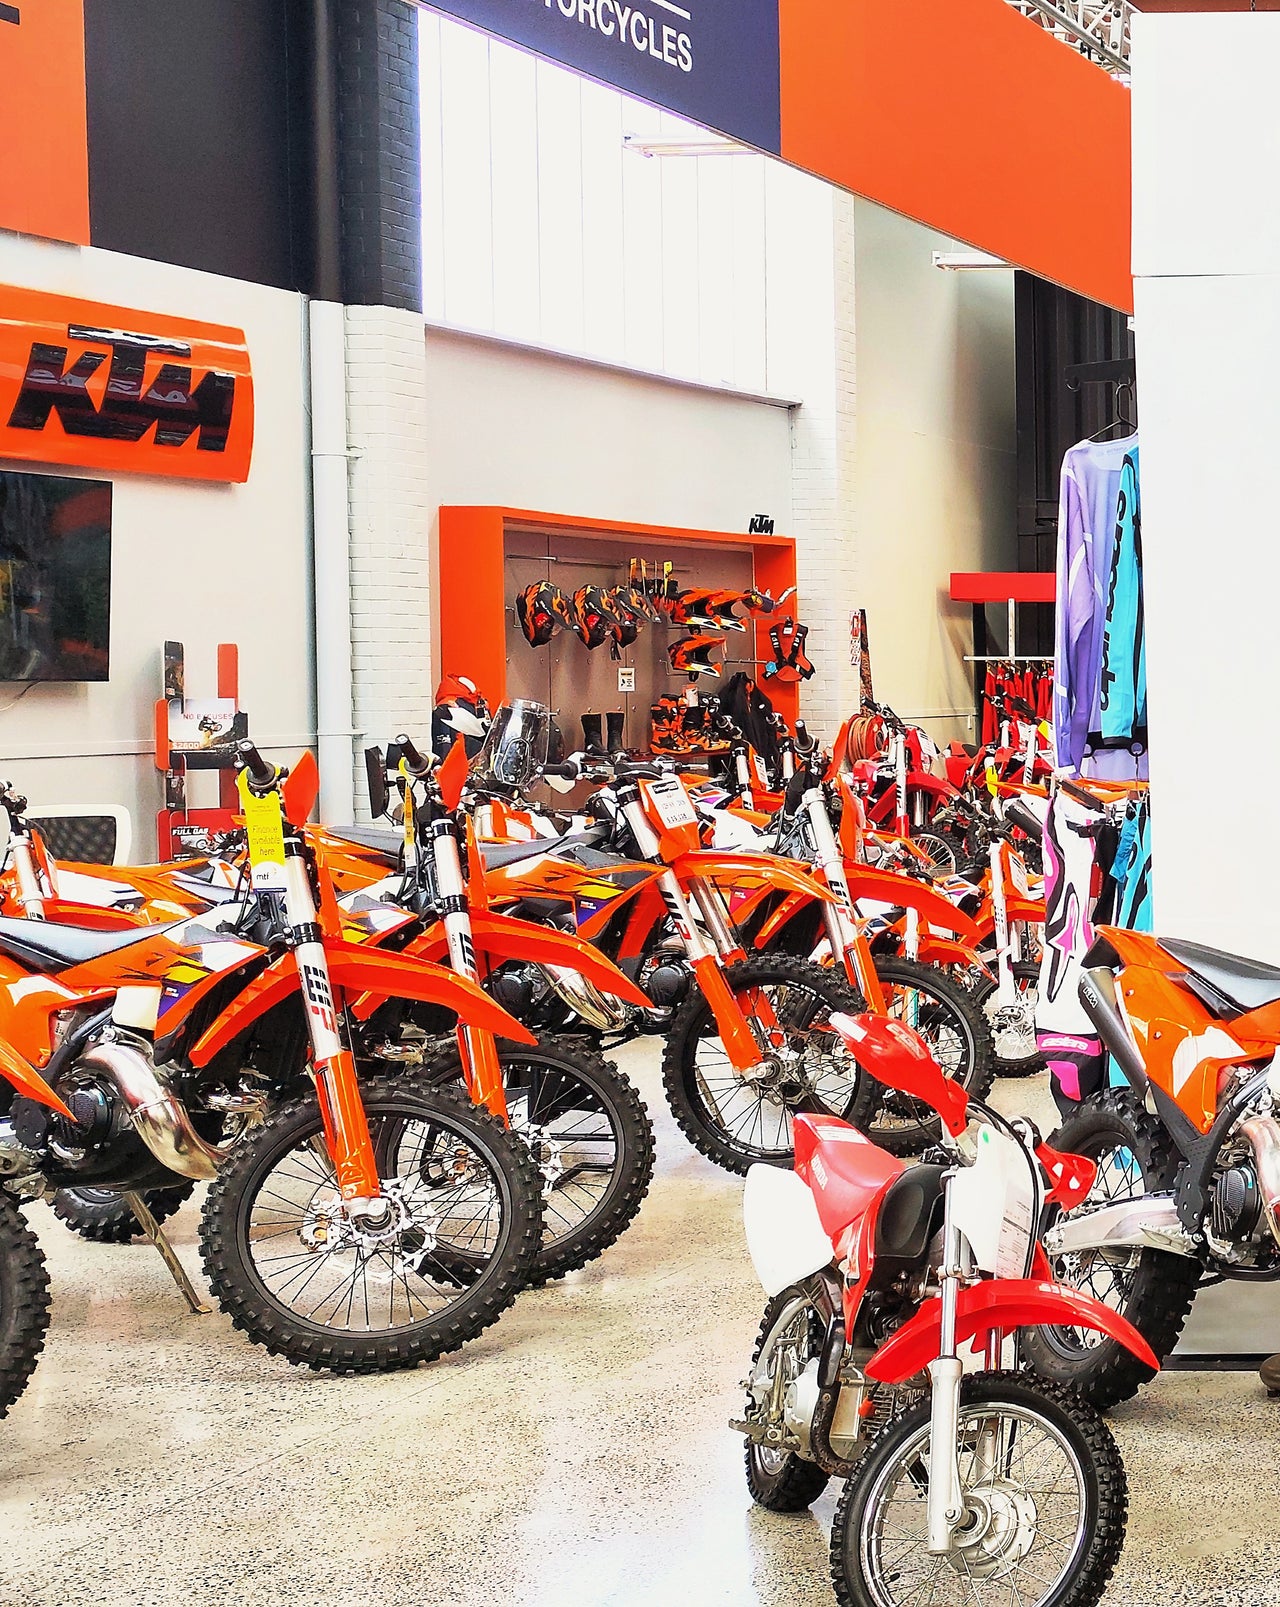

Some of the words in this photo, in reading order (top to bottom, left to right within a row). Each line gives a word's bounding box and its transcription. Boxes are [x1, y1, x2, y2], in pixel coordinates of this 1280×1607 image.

[8, 324, 235, 452] KTM
[749, 514, 774, 535] KTM
[256, 872, 270, 880] mtf
[1083, 986, 1099, 1009] KTM
[811, 1154, 829, 1191] HONDA
